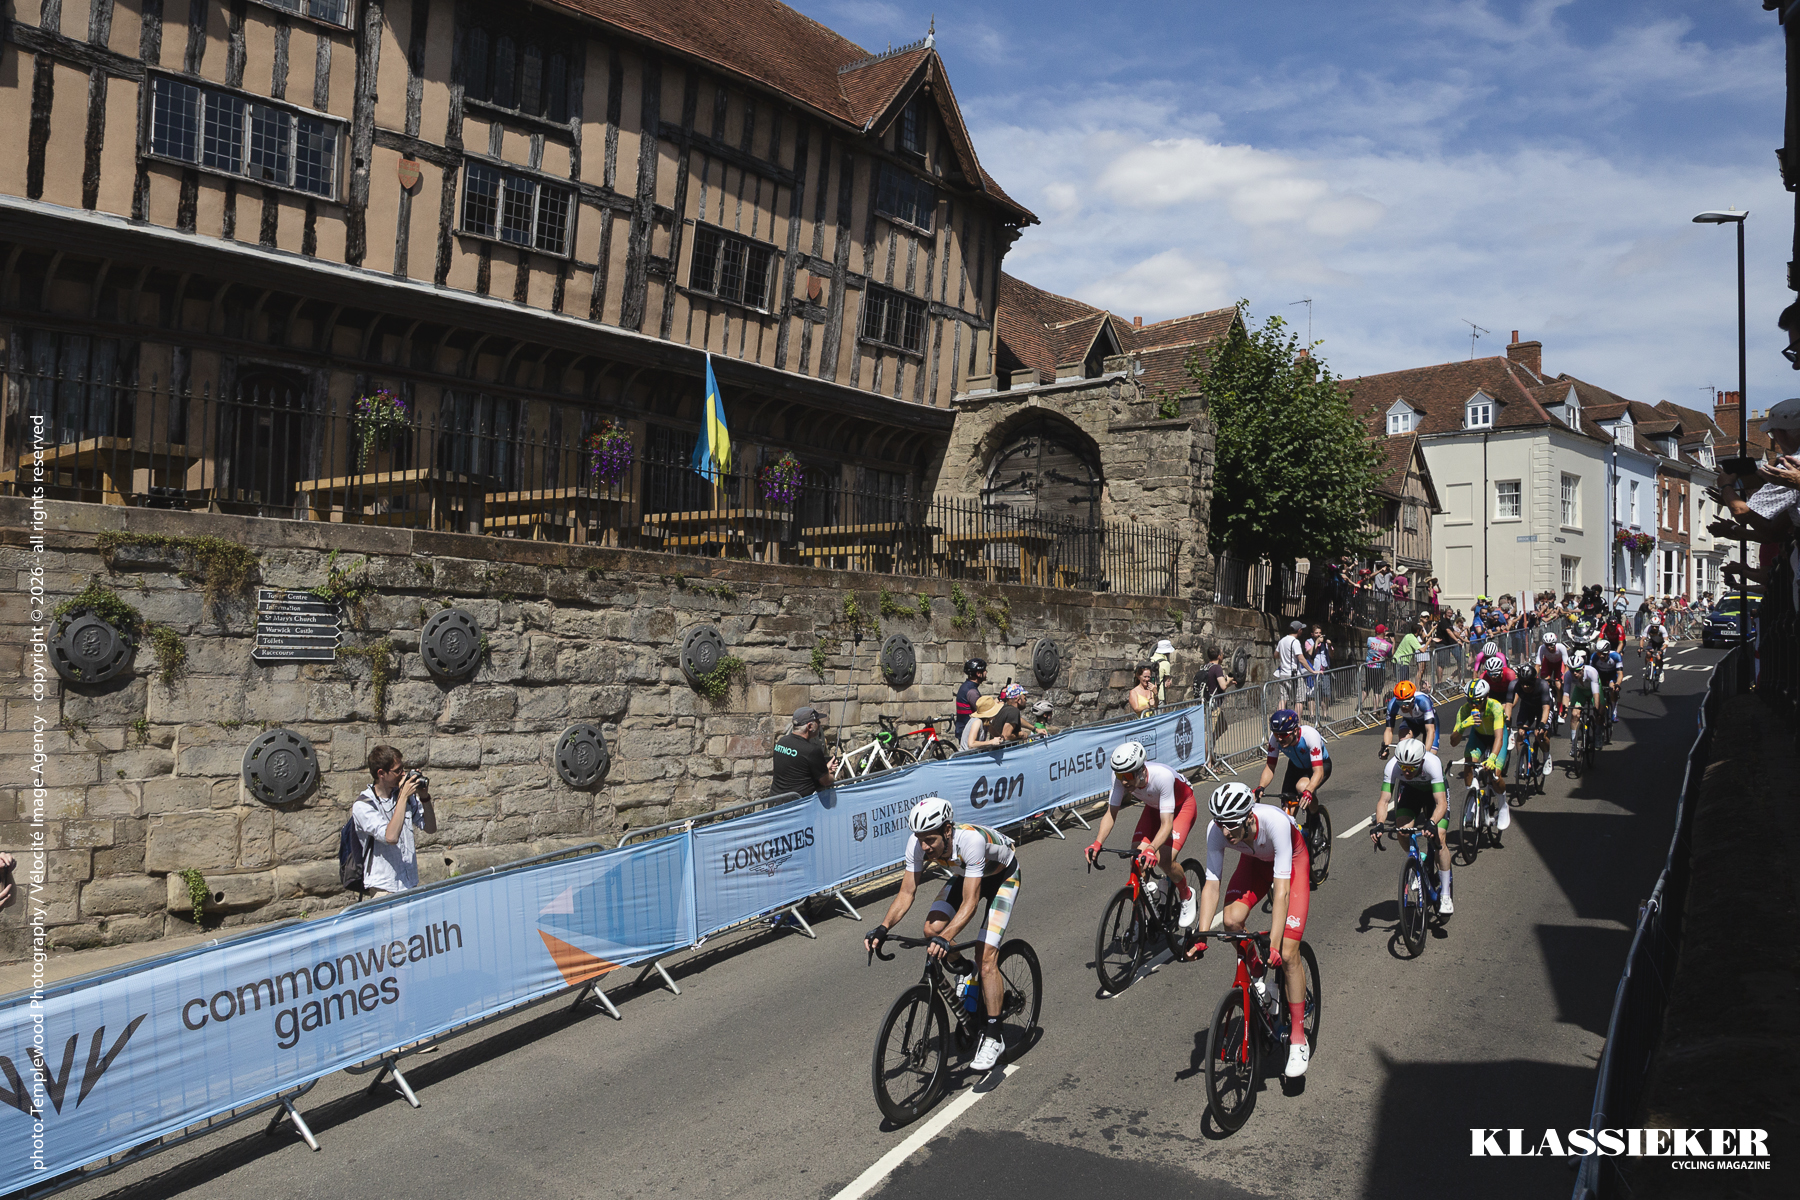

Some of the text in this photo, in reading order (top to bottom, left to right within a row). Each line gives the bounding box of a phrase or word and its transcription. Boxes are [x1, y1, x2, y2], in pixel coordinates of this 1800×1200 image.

[273, 615, 293, 623] Mary's
[293, 615, 317, 623] Church
[1049, 751, 1093, 782] CHASE
[872, 814, 910, 839] BIRMIN
[722, 826, 815, 875] LONGINES
[182, 920, 463, 1031] commonwealth
[274, 976, 400, 1050] games
